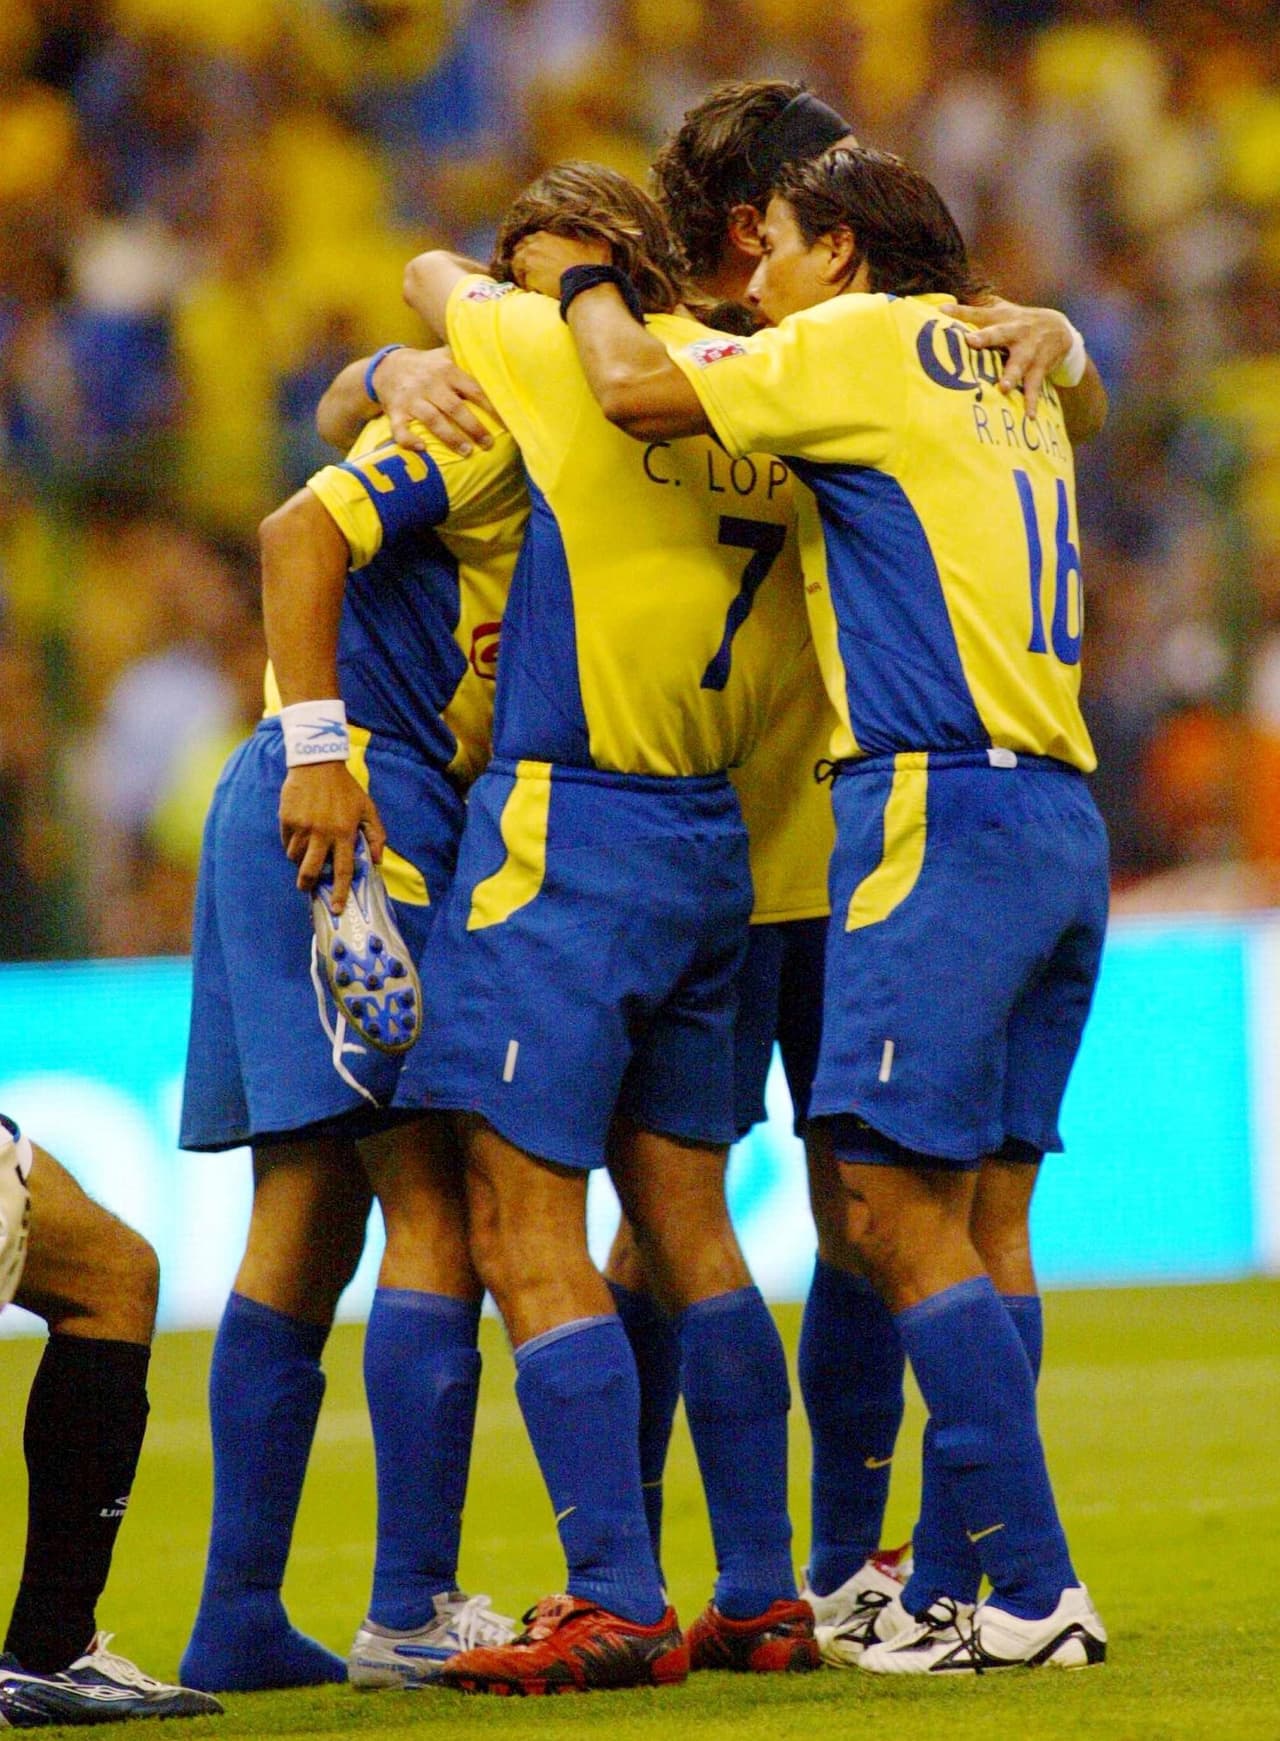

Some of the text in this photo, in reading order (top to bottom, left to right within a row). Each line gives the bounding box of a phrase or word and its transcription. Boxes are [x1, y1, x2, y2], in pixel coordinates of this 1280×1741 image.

[643, 442, 681, 486] C.
[699, 514, 787, 692] 7
[1013, 469, 1084, 665] 16
